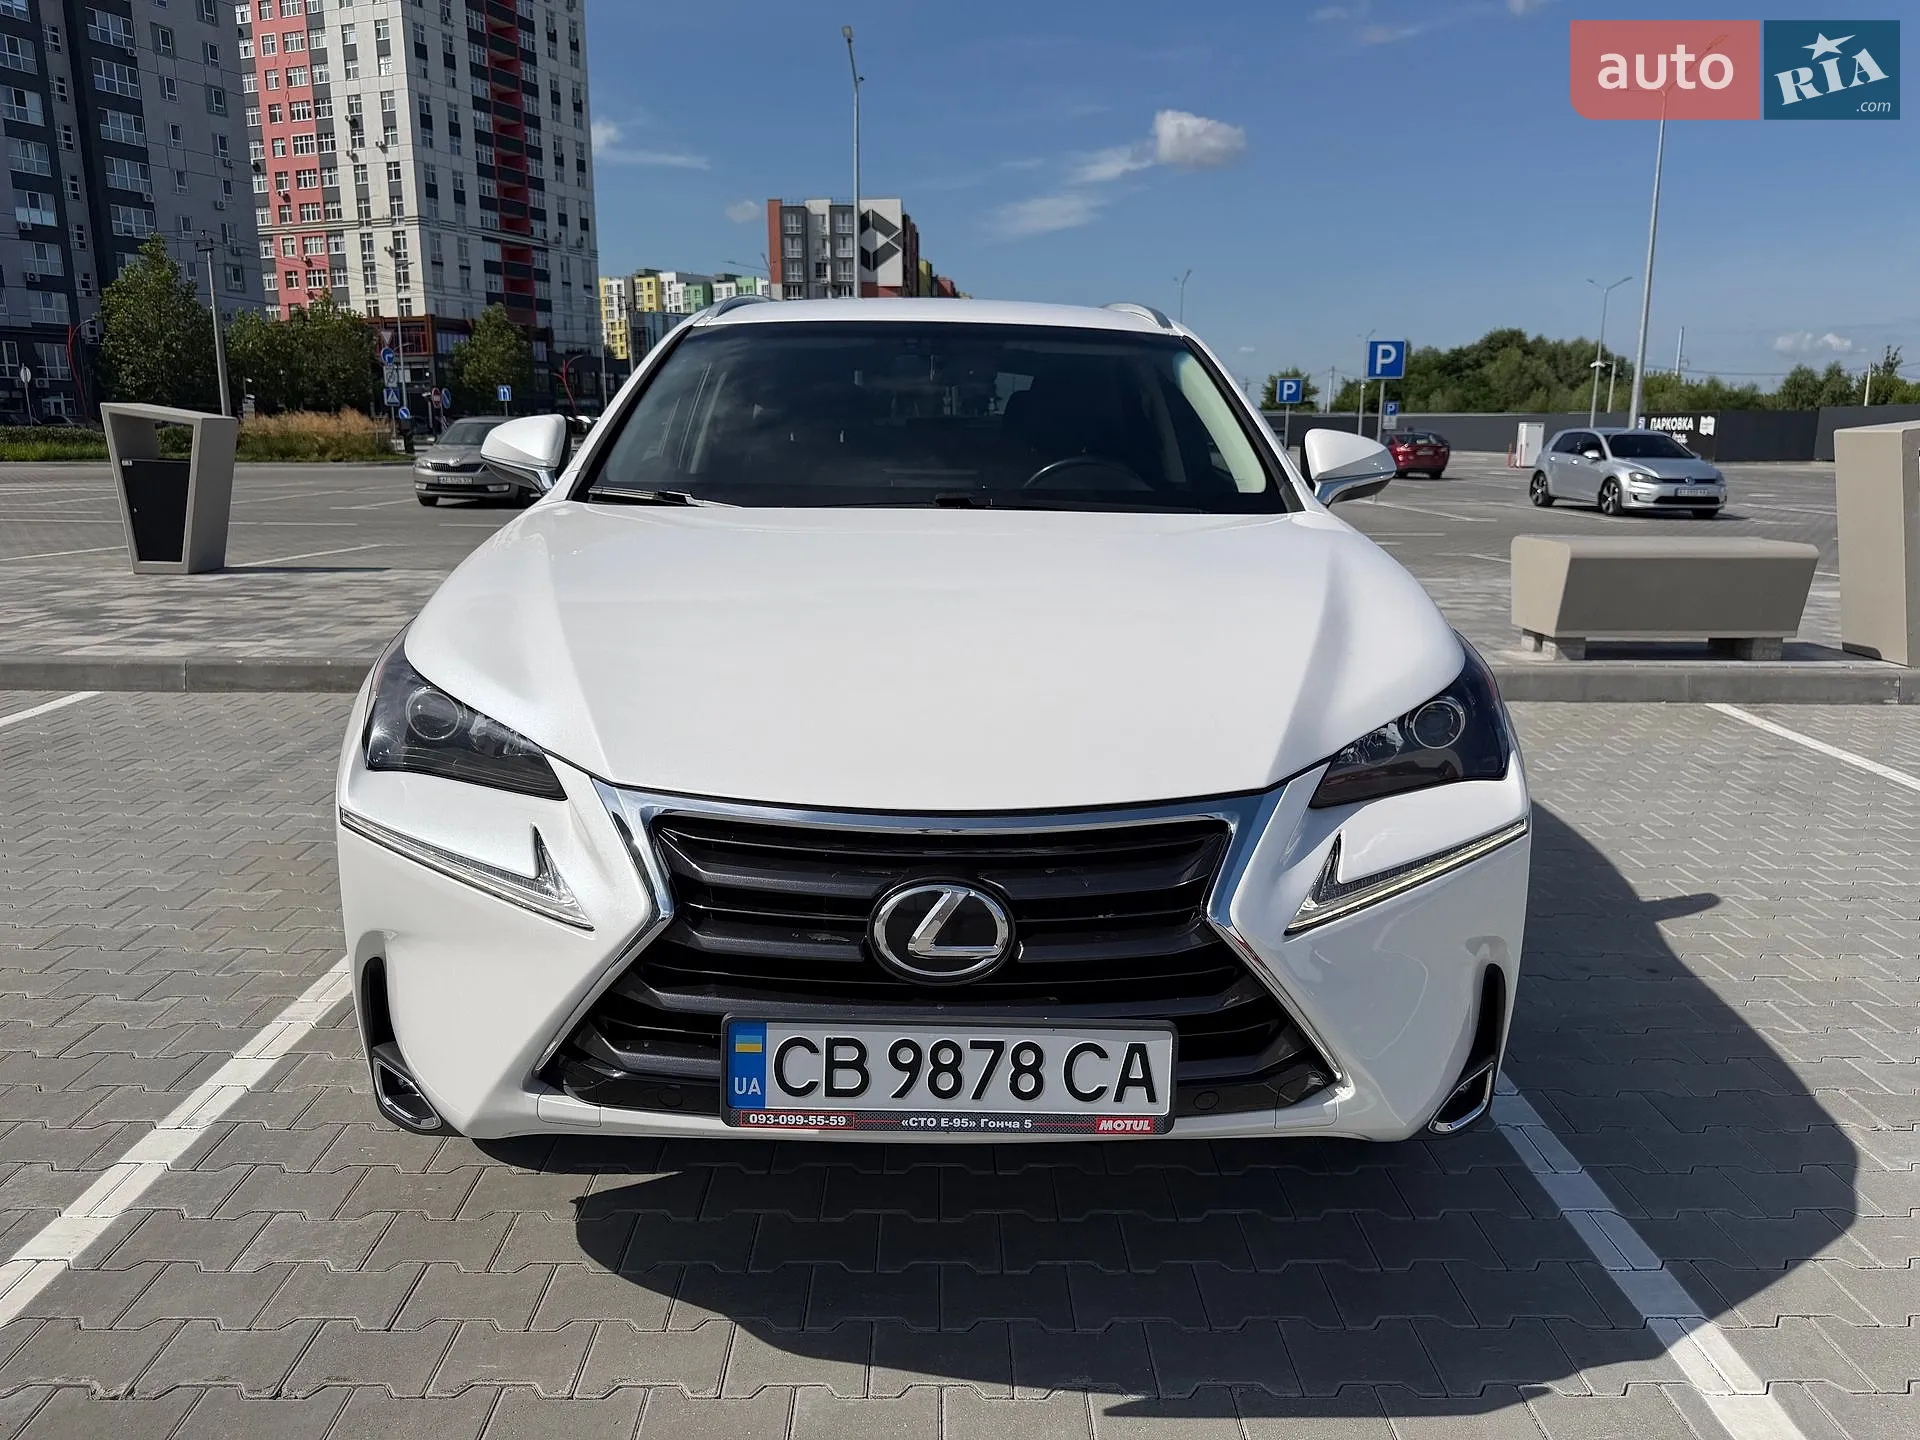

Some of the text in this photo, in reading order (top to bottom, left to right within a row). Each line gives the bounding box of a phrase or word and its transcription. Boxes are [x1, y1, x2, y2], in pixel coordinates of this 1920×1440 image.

[1376, 344, 1396, 374] P
[1283, 381, 1296, 400] P
[1650, 417, 1693, 430] ПАРКОВКА
[773, 1036, 1157, 1103] CB 9878 CA
[734, 1077, 761, 1095] UA
[749, 1113, 846, 1126] 093-099-55-59
[901, 1117, 937, 1128] «СТО
[980, 1118, 1020, 1129] Гонча
[1024, 1119, 1032, 1129] 5
[1098, 1119, 1151, 1132] MOTUL
